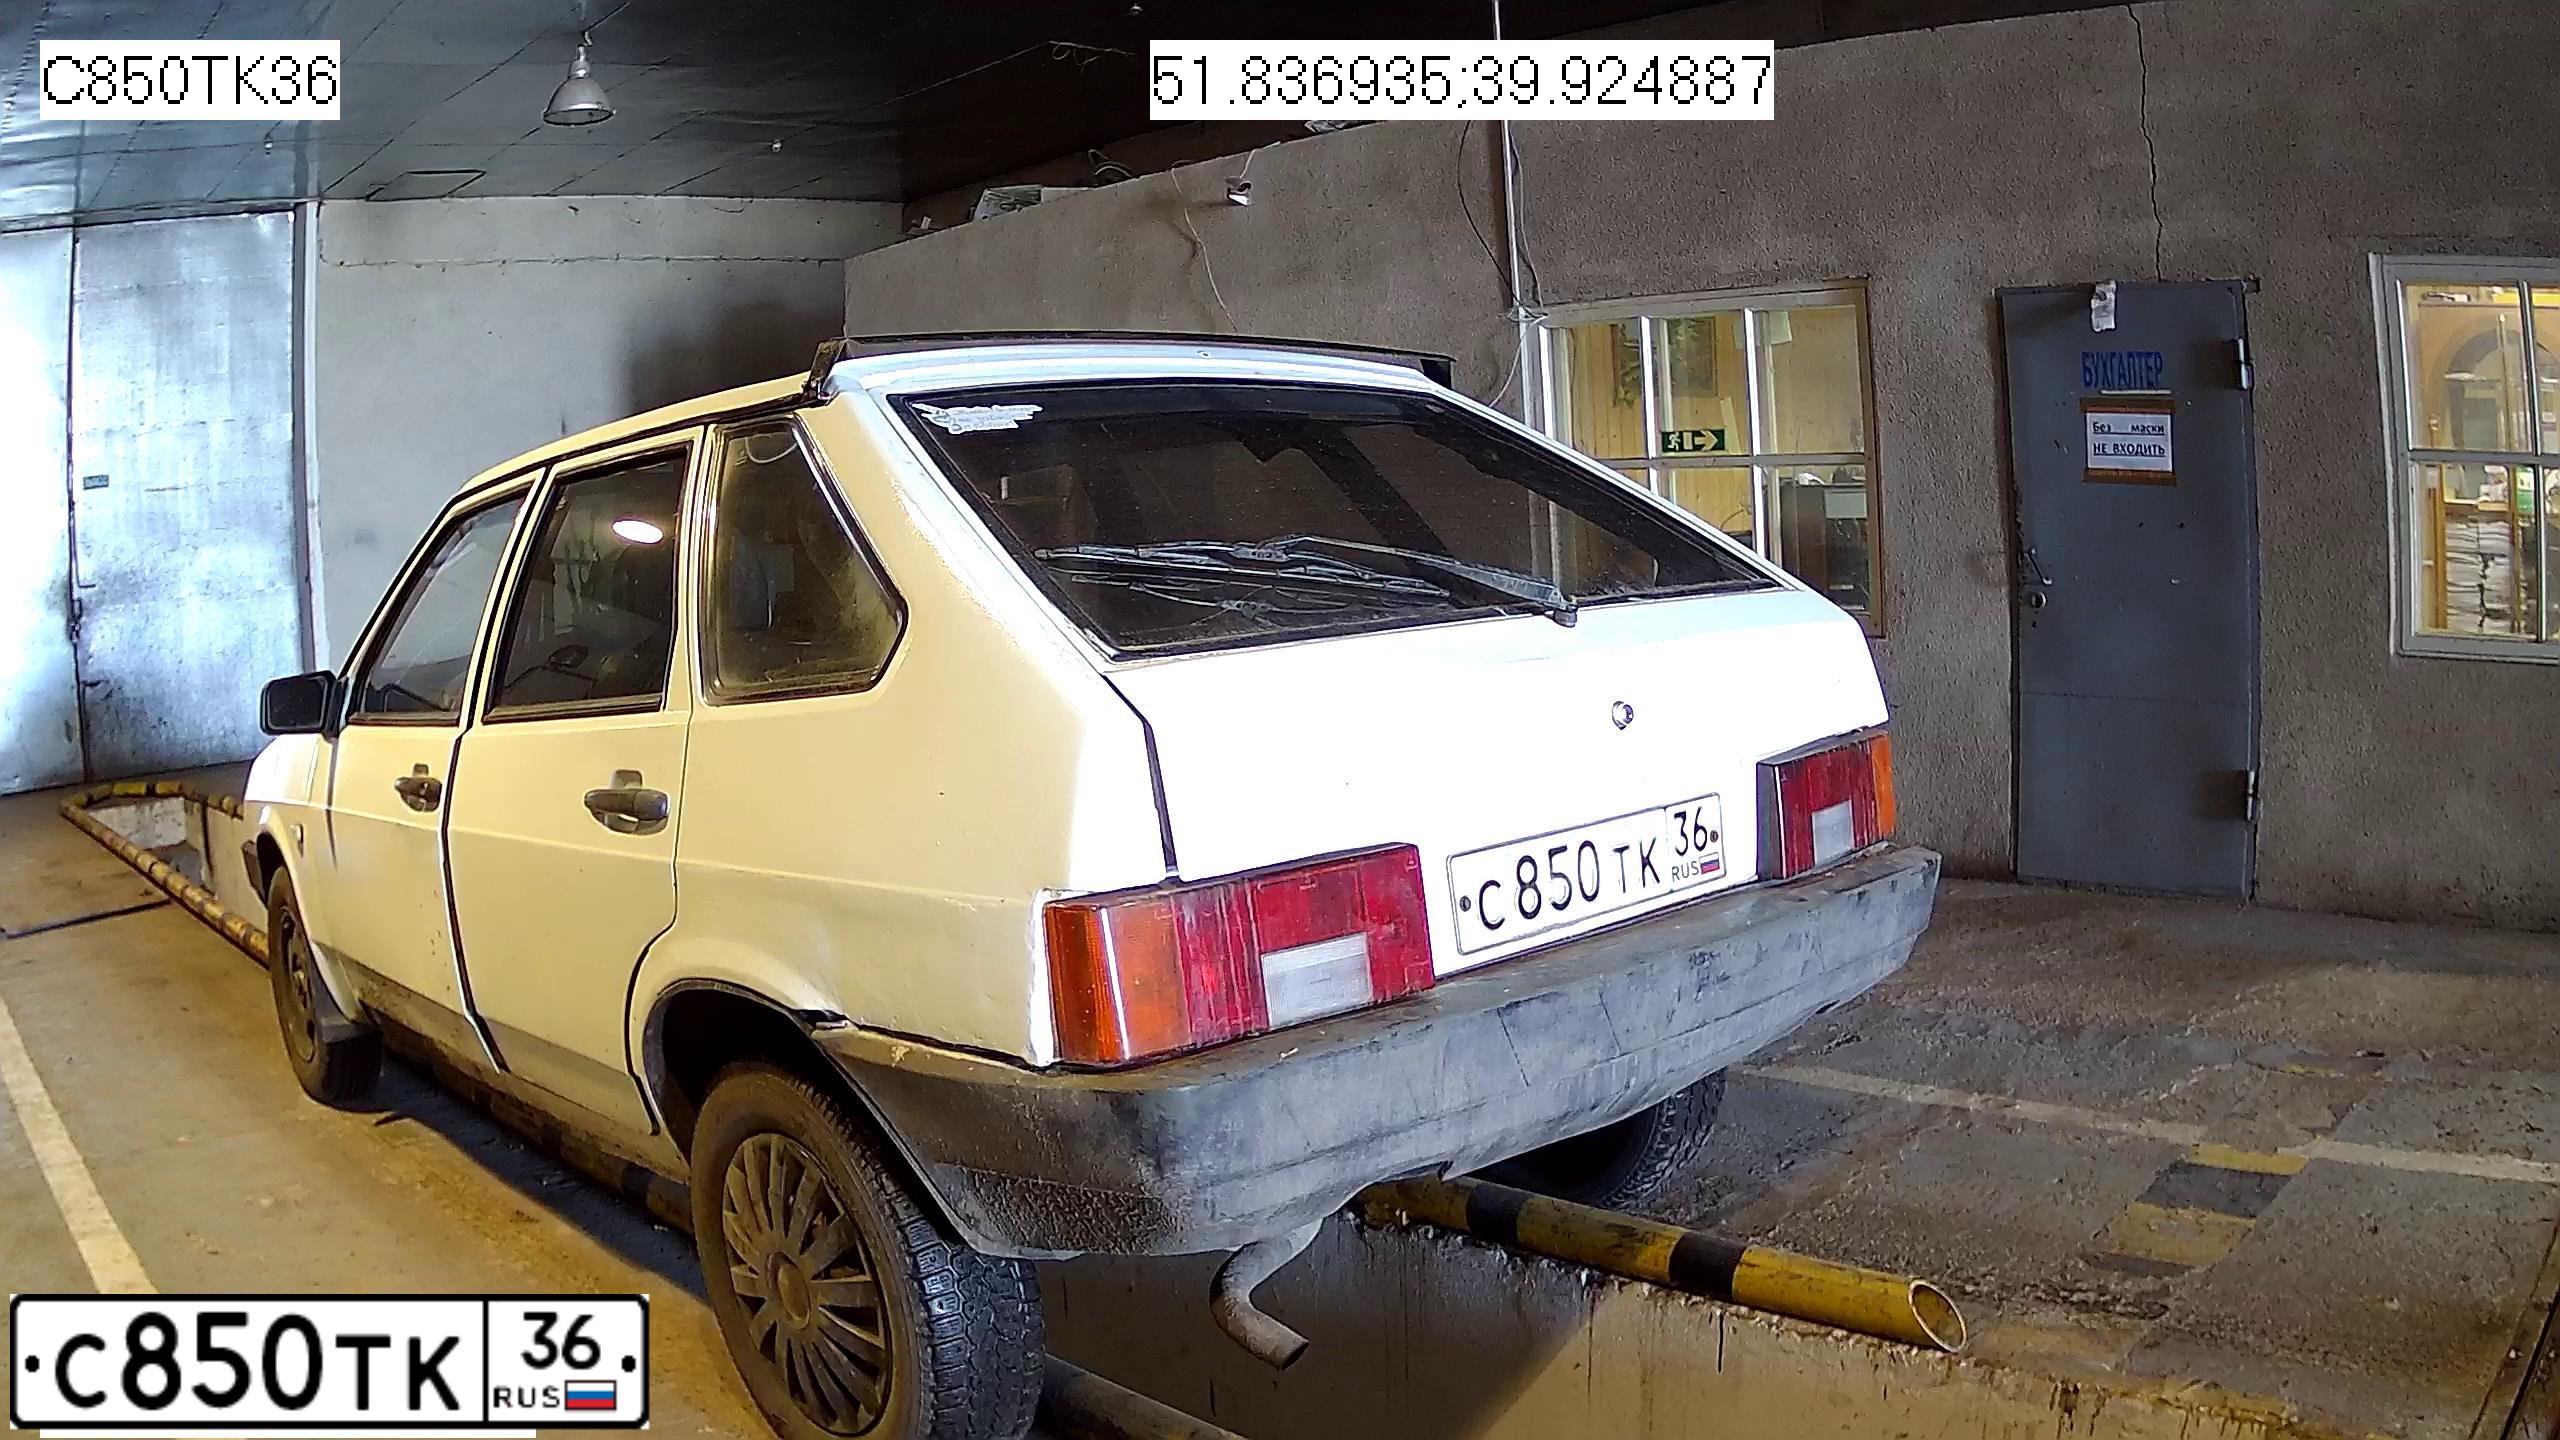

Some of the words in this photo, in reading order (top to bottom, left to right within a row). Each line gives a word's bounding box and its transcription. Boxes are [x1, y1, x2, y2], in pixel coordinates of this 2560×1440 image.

[2081, 351, 2163, 390] БУХГАЛТЕР
[2092, 422, 2112, 433] Без
[2130, 424, 2165, 434] маски
[2093, 443, 2109, 455] НЕ
[2113, 443, 2165, 456] ВХОДИТЬ
[1673, 806, 1708, 857] 36
[1671, 860, 1700, 881] RUS
